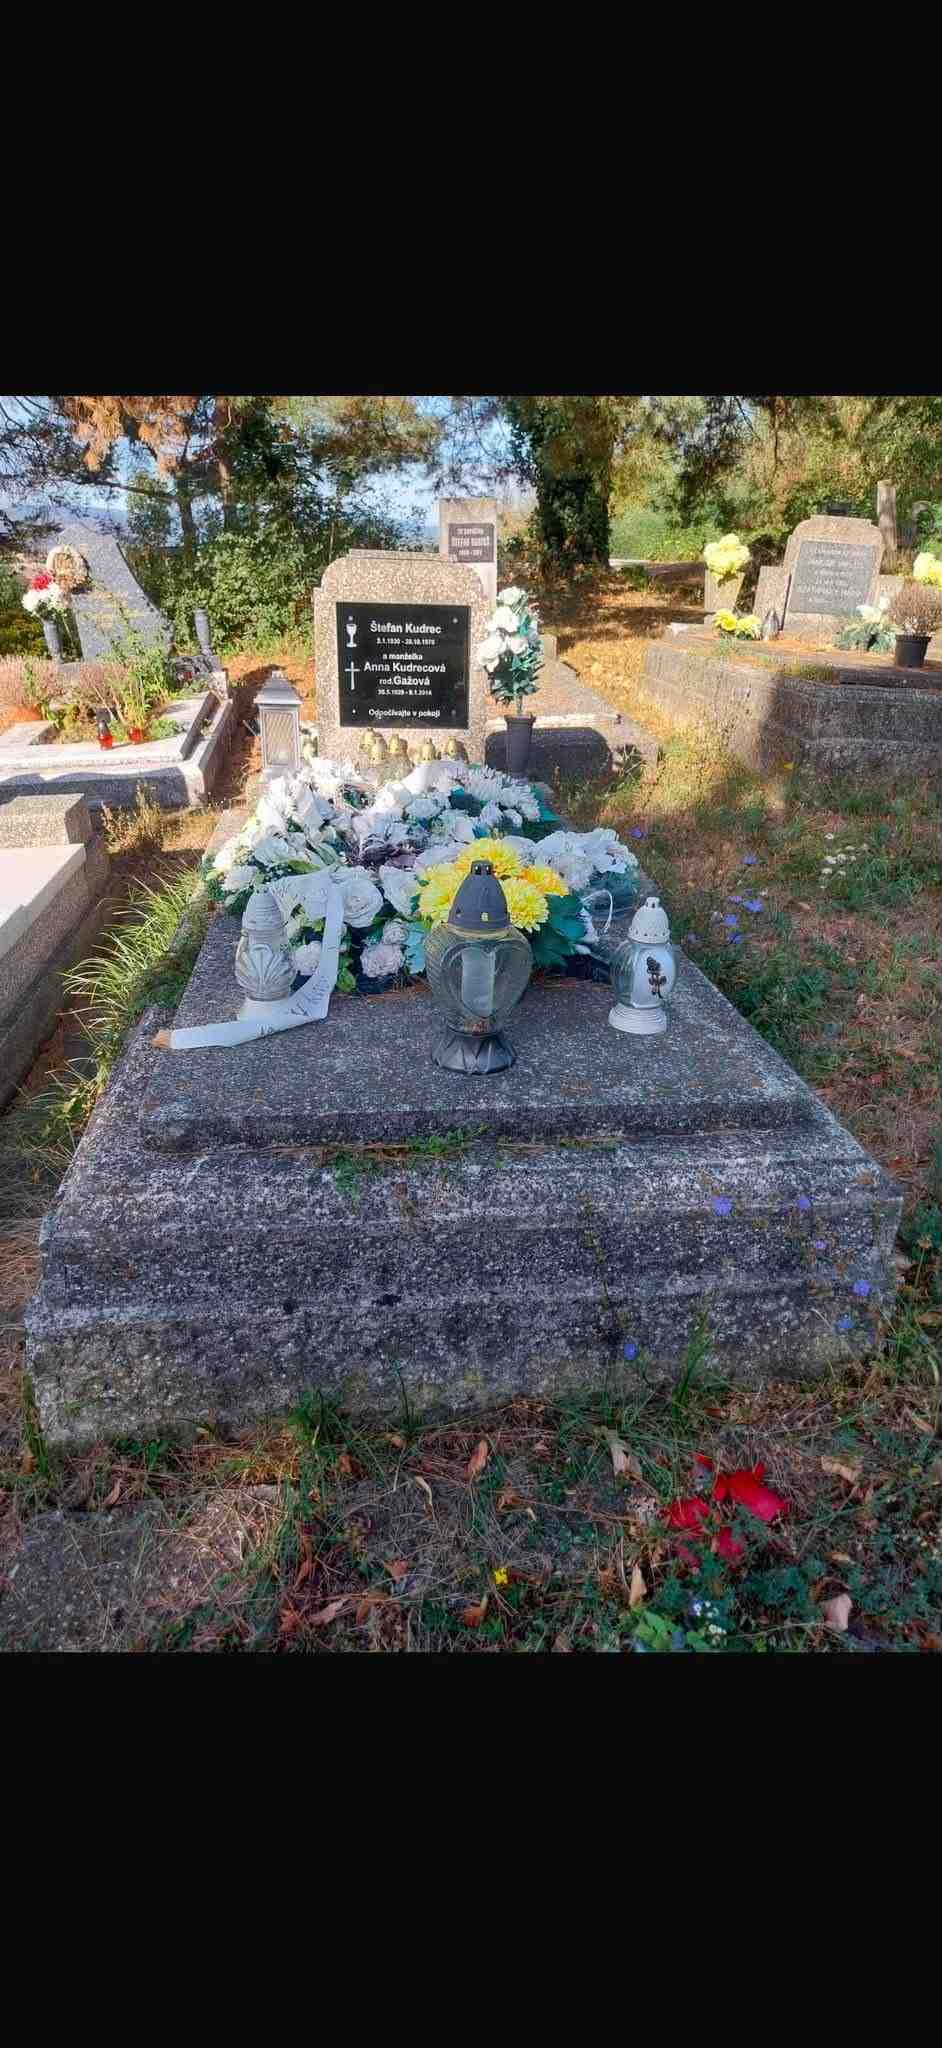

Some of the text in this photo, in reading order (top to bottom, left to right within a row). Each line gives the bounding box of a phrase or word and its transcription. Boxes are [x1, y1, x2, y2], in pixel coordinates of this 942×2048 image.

[370, 620, 441, 634] Štefan Kudrec
[389, 652, 423, 660] manželka
[364, 661, 446, 673] Anna Kudrecová
[368, 708, 411, 718] Odpočívajte
[418, 709, 441, 718] pokoji
